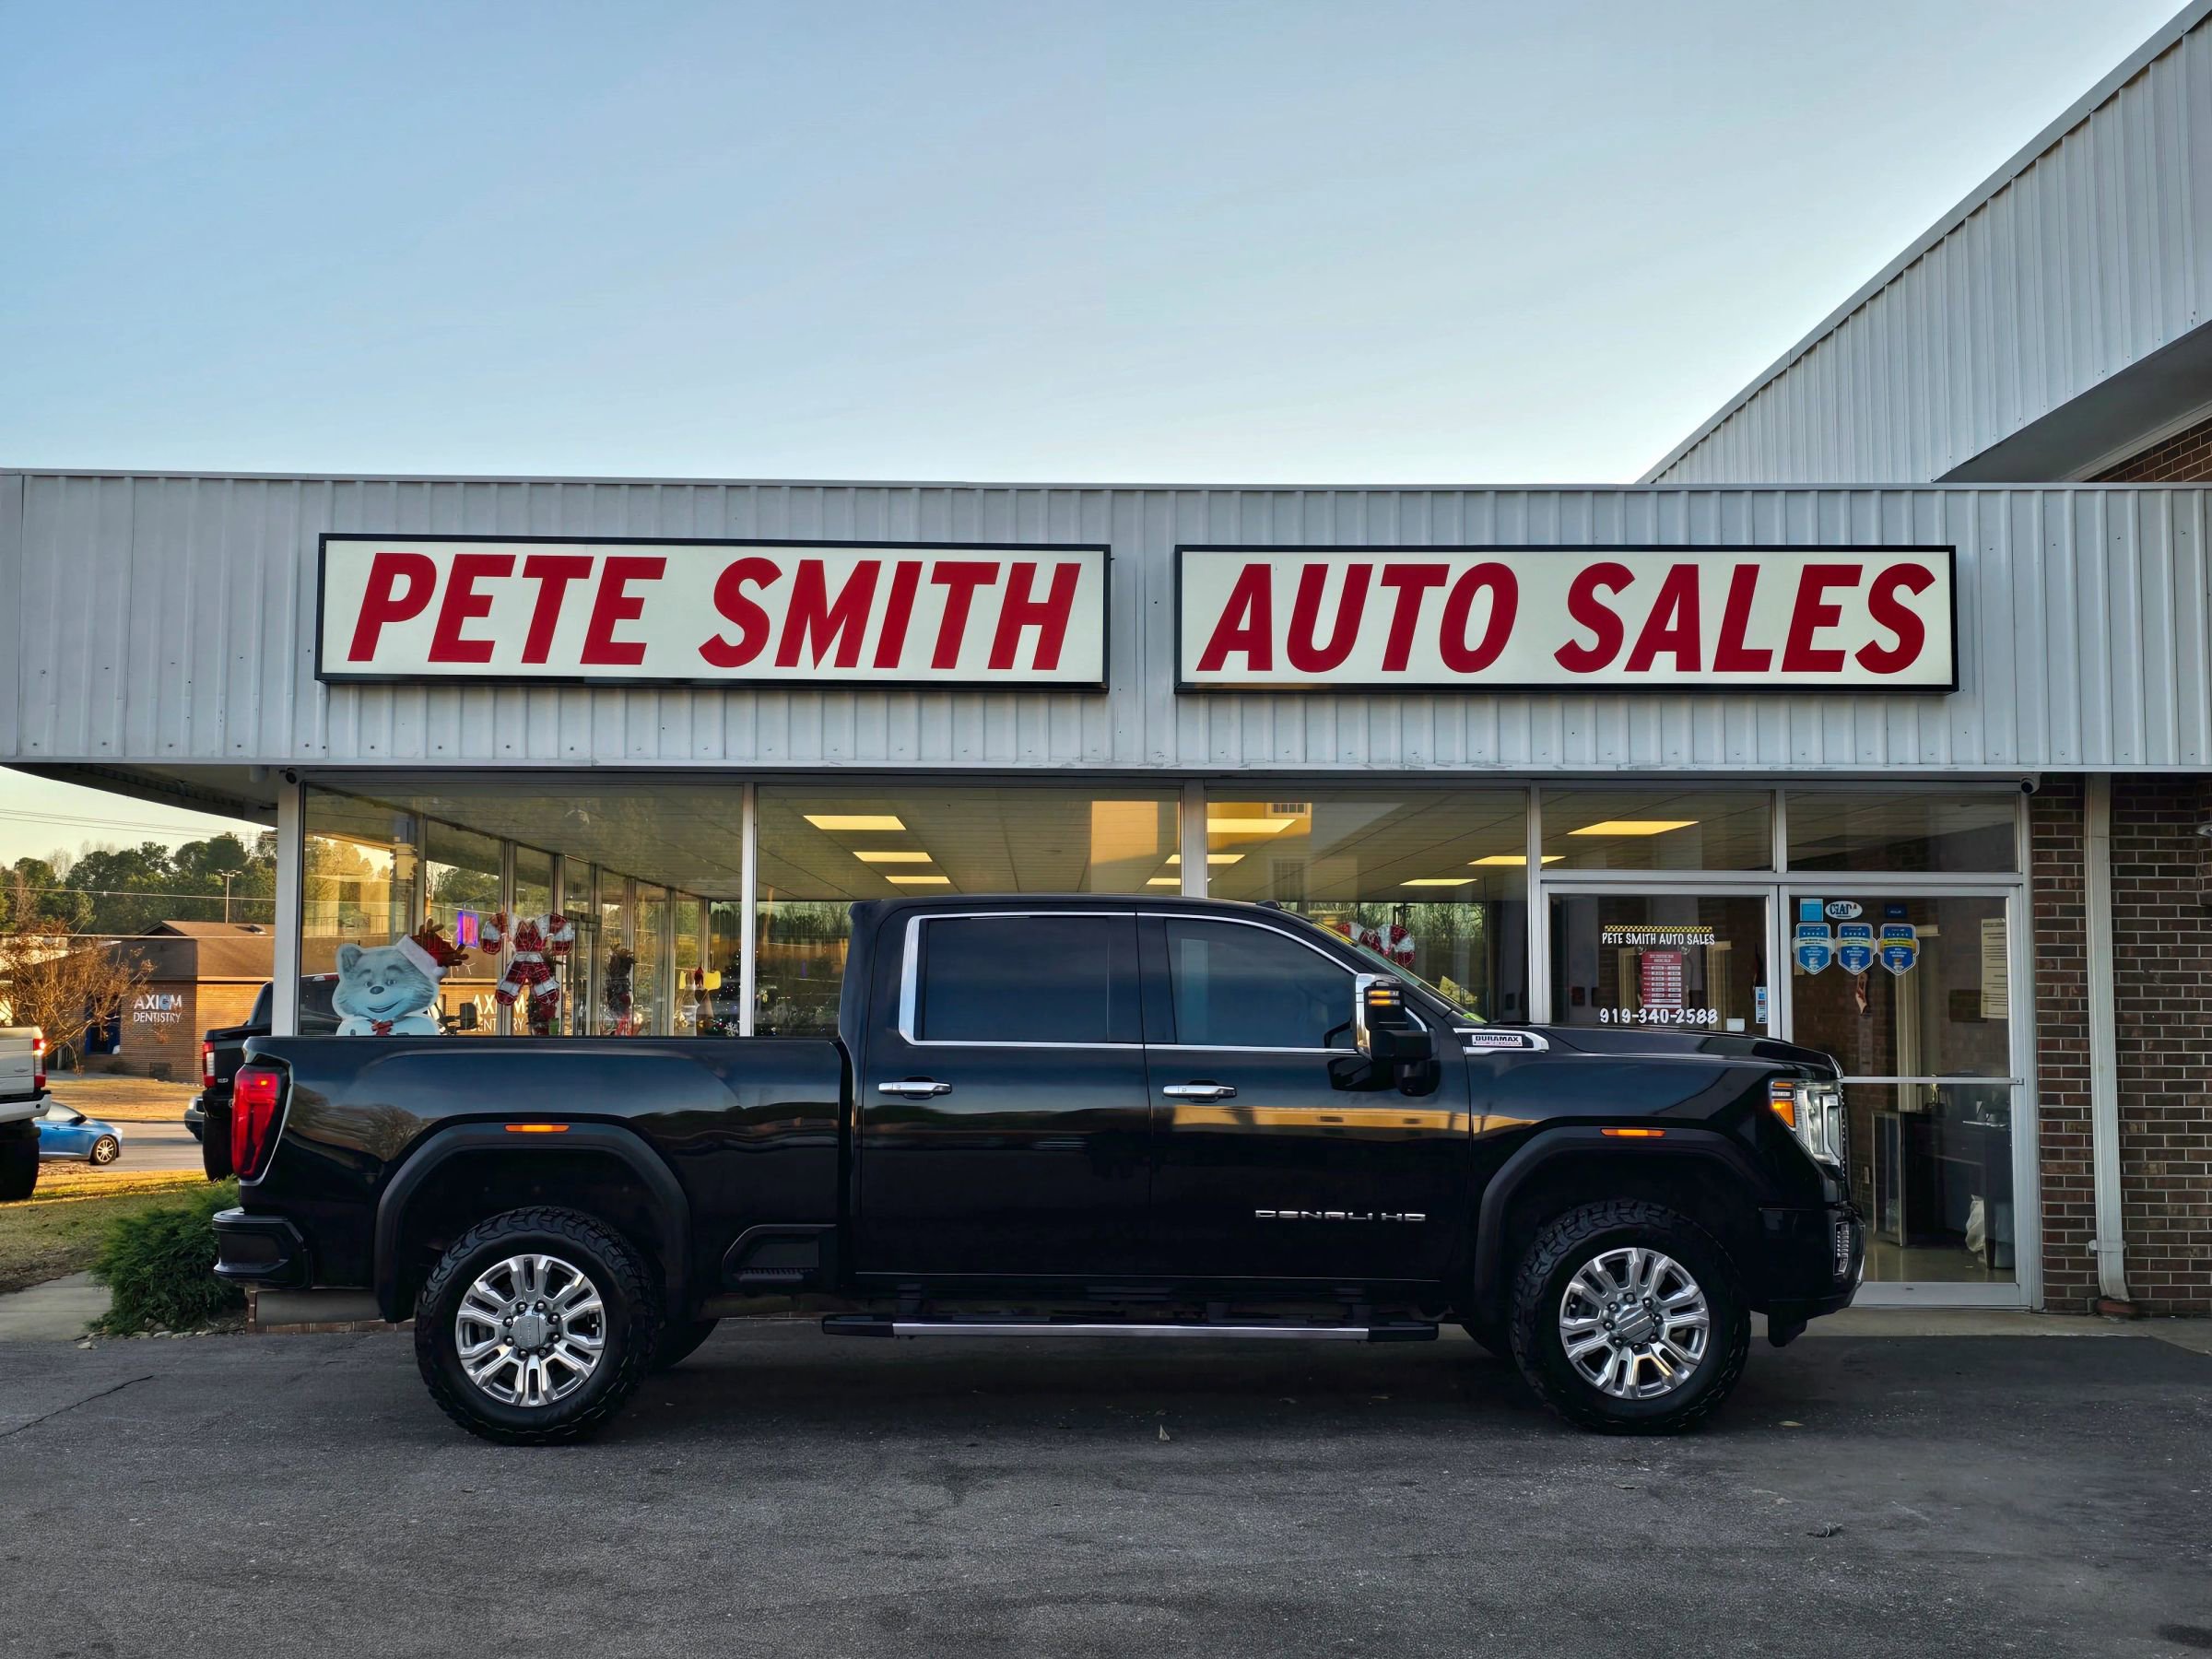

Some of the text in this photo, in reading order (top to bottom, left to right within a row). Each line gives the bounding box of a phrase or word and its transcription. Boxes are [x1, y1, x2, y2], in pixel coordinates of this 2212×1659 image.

[349, 553, 1079, 669] PETE SMITH
[1198, 563, 1933, 673] AUTO SALES
[1602, 933, 1714, 945] PETE SMITH AUTO SALES
[134, 994, 182, 1010] AXIOM
[134, 1012, 182, 1023] DENTISTRY
[1599, 1007, 1718, 1024] 919-340-2588
[1255, 1210, 1426, 1221] DENALI HD
